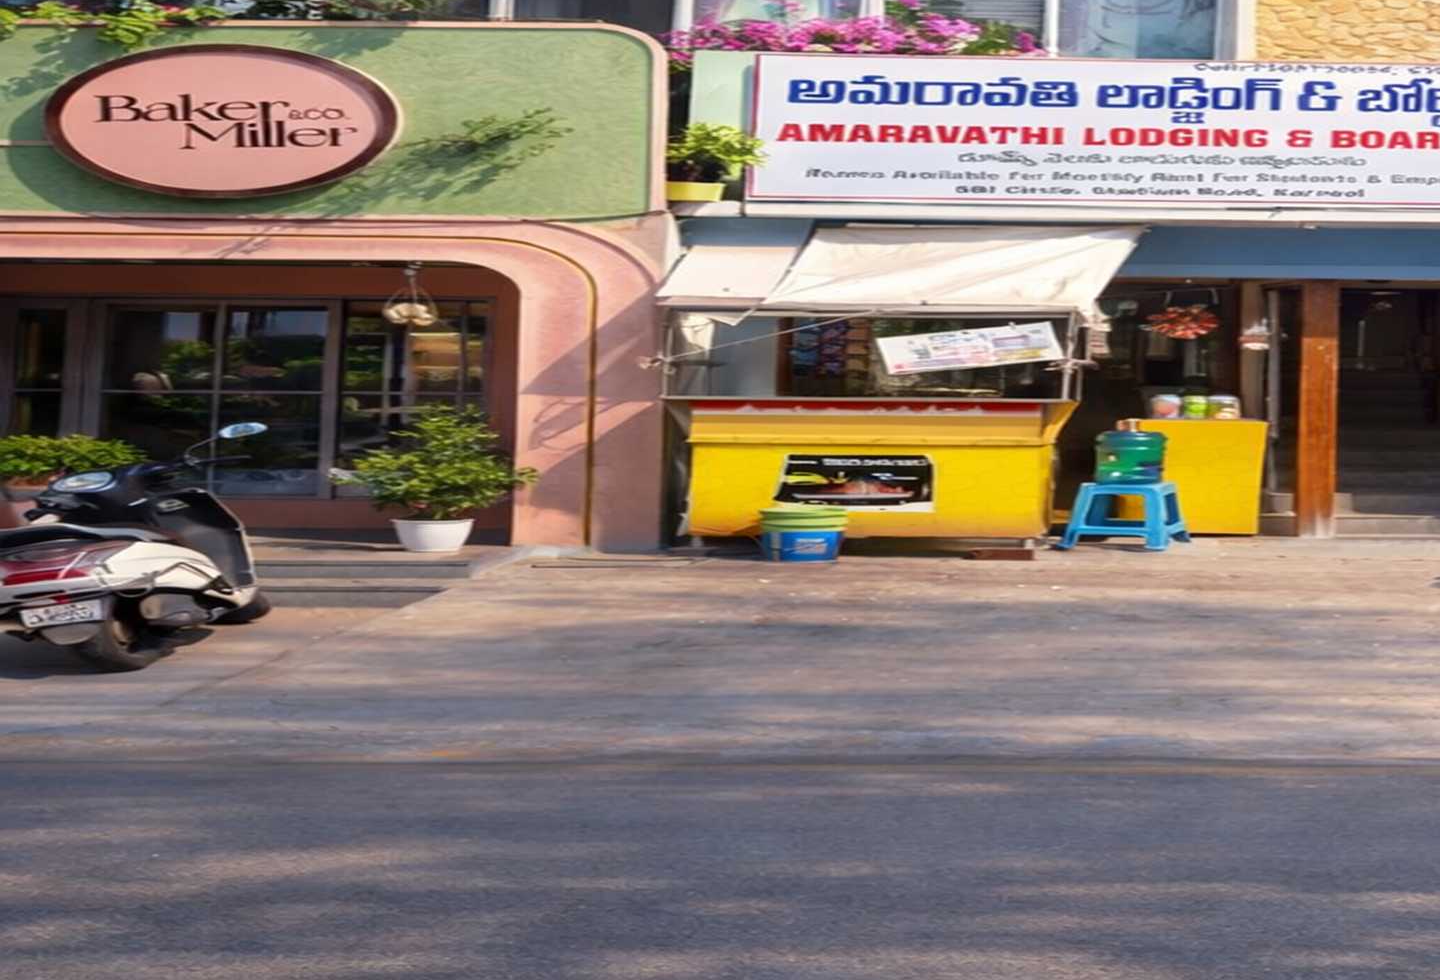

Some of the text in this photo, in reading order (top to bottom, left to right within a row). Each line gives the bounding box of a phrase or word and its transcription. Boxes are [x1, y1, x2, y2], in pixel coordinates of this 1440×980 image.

[94, 93, 290, 123] Baker
[787, 75, 1079, 109] అమరావతి
[1297, 80, 1338, 112] &
[179, 121, 358, 150] Miller
[776, 123, 1065, 146] AMARAVATHI
[1083, 126, 1269, 149] LODGING
[1286, 129, 1312, 149] &
